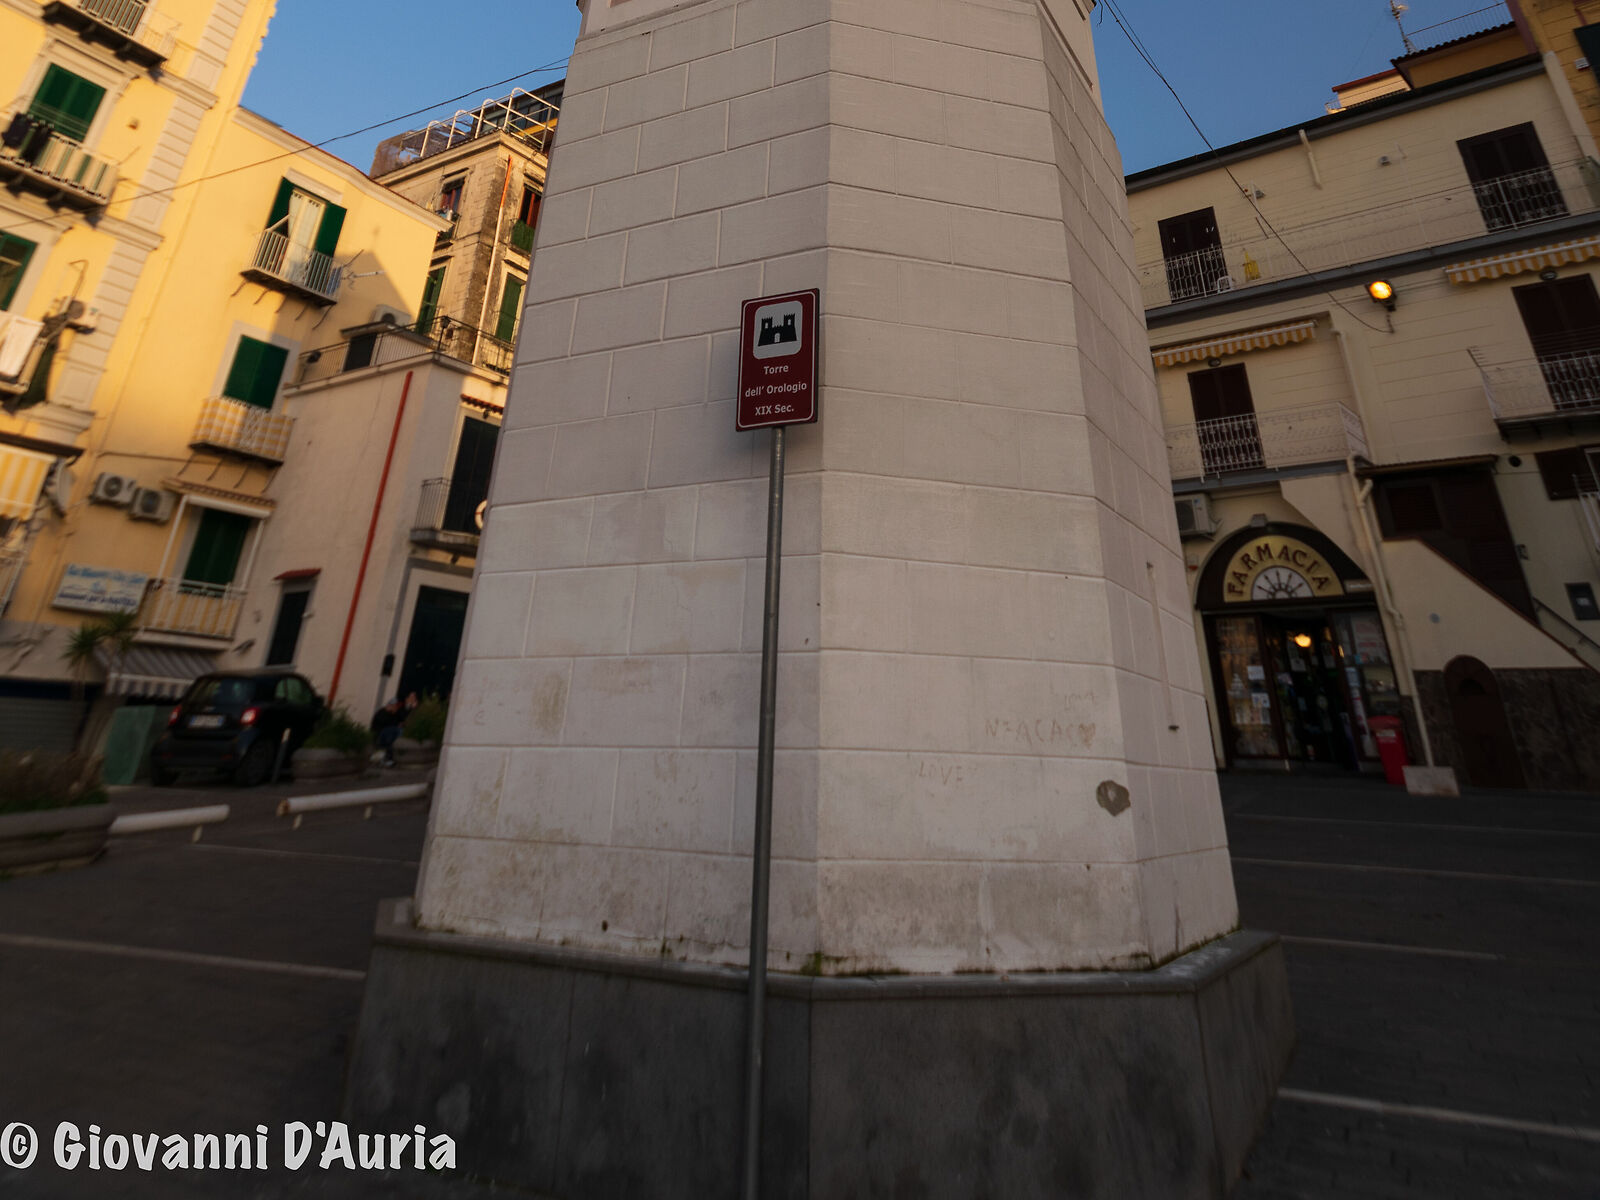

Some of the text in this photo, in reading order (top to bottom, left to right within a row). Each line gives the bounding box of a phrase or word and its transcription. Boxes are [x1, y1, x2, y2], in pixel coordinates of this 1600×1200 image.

[763, 365, 788, 374] Torre
[745, 381, 807, 398] dell' Orologio
[755, 403, 795, 416] XIX Sec.
[1227, 543, 1332, 596] FARMACIA
